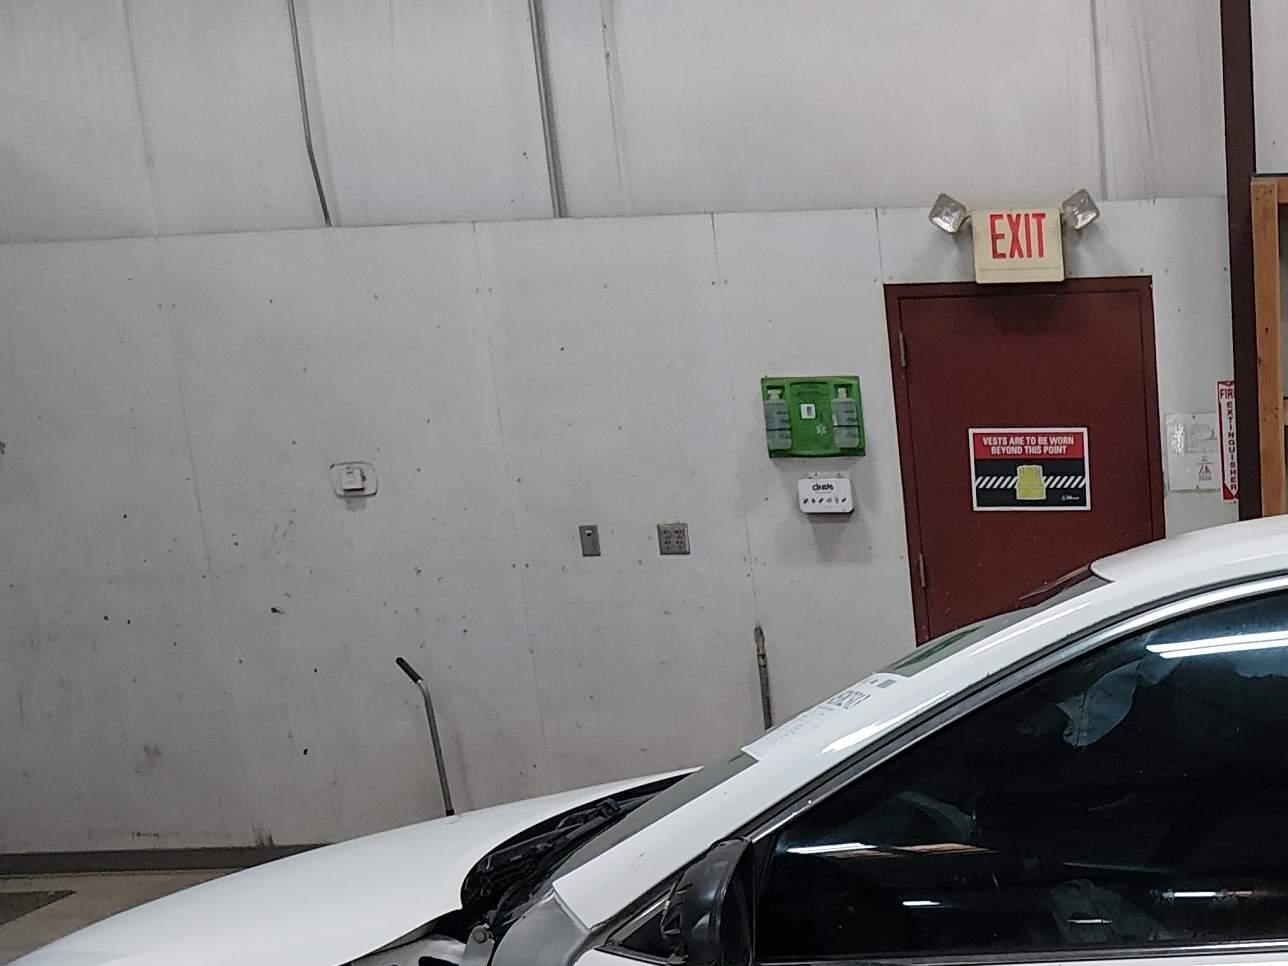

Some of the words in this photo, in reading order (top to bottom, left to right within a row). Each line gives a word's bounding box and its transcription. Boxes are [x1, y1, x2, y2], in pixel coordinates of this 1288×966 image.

[989, 212, 1046, 259] EXIT
[1220, 388, 1234, 400] FIR
[982, 436, 1008, 446] VESTS
[1008, 436, 1025, 446] ARE
[1026, 436, 1037, 446] TO
[1037, 436, 1049, 446] BE
[1049, 436, 1074, 446] WORN
[1225, 401, 1237, 491] EXTINGUISHER
[990, 446, 1023, 455] BEYOND
[1025, 446, 1043, 455] THIS
[1043, 446, 1067, 455] POINT
